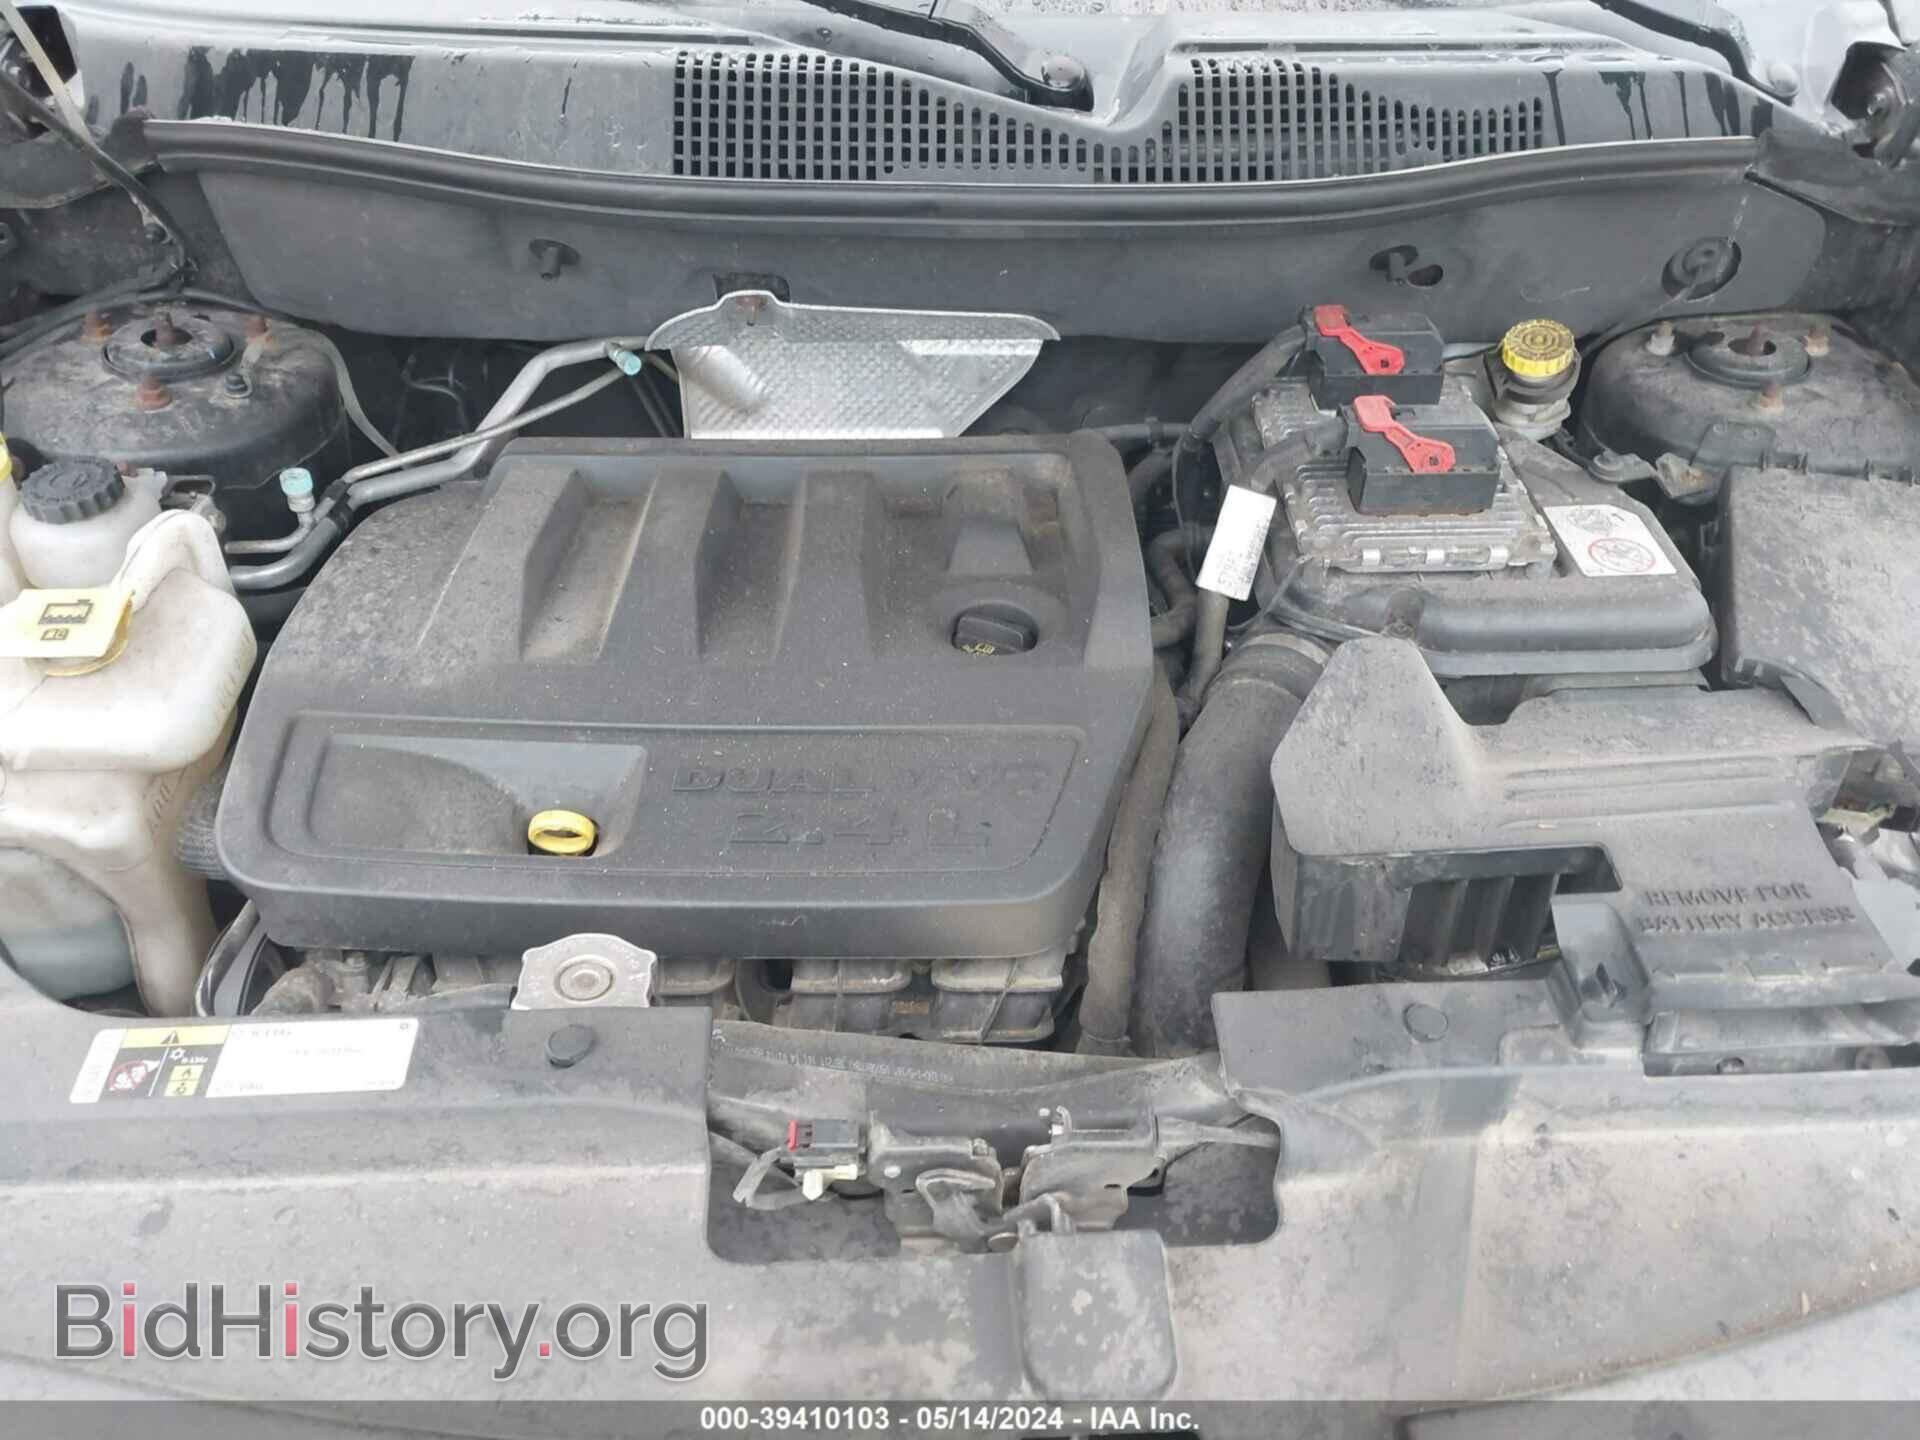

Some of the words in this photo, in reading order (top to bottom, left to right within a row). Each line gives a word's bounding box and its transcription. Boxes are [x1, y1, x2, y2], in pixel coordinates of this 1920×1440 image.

[672, 766, 875, 793] DUAL
[1643, 888, 1747, 907] REMOVE
[1756, 882, 1811, 902] FOR
[1636, 912, 1744, 932] BATTERY
[1752, 906, 1856, 929] ACCESS
